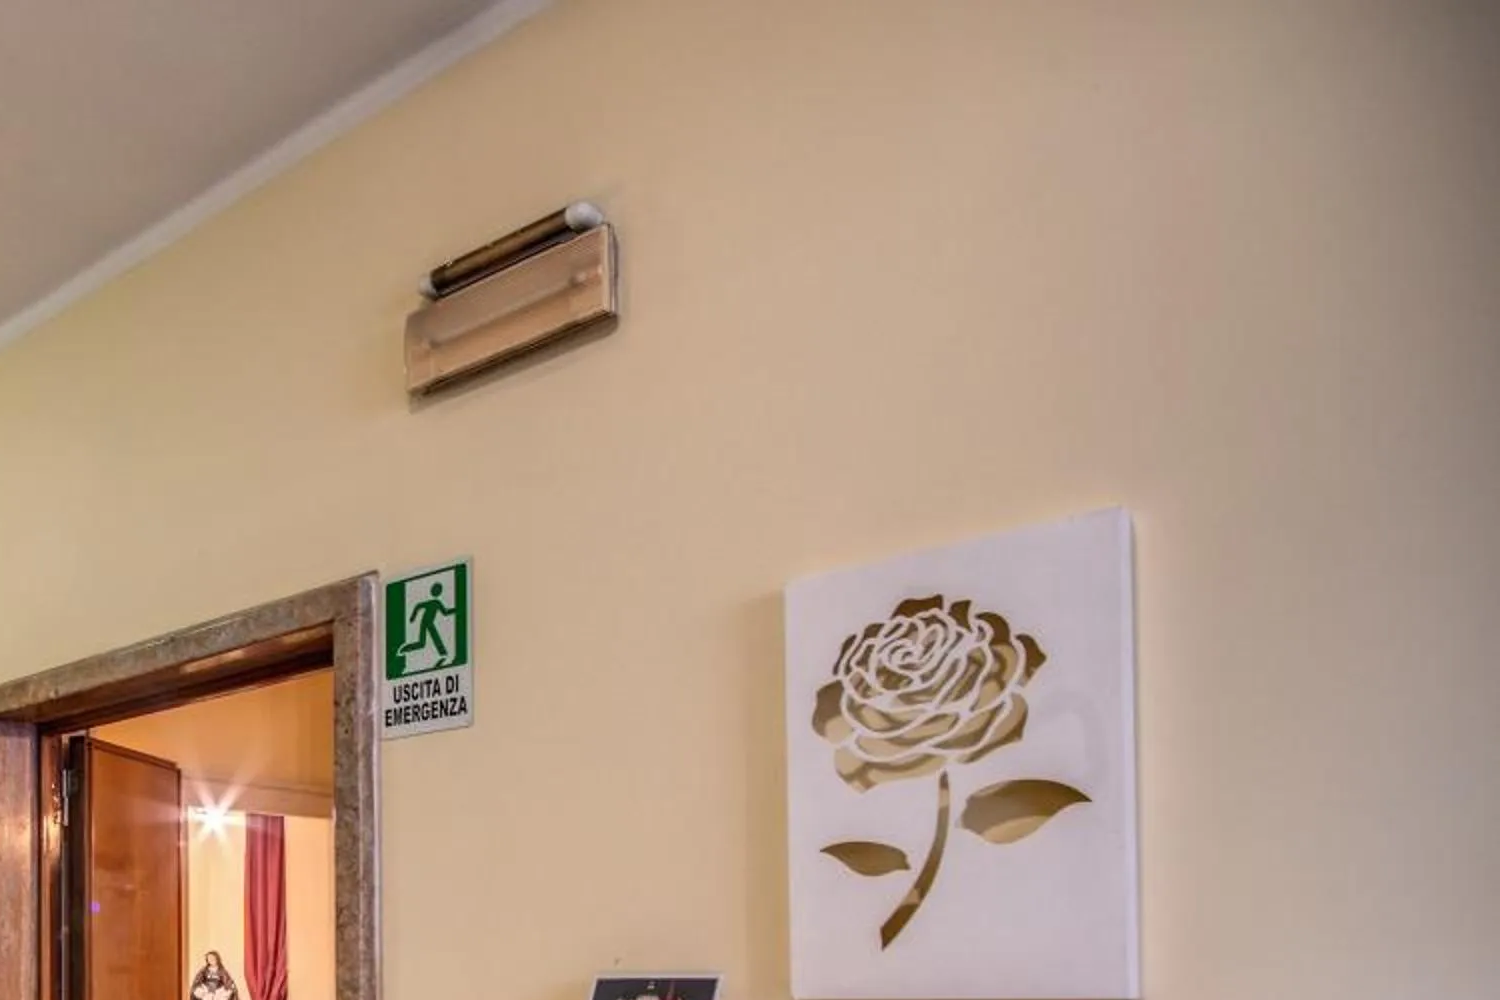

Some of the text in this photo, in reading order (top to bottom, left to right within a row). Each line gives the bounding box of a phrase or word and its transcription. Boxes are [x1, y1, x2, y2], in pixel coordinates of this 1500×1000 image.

[393, 674, 459, 703] USCITA DI
[385, 696, 467, 727] EMERGENZA
